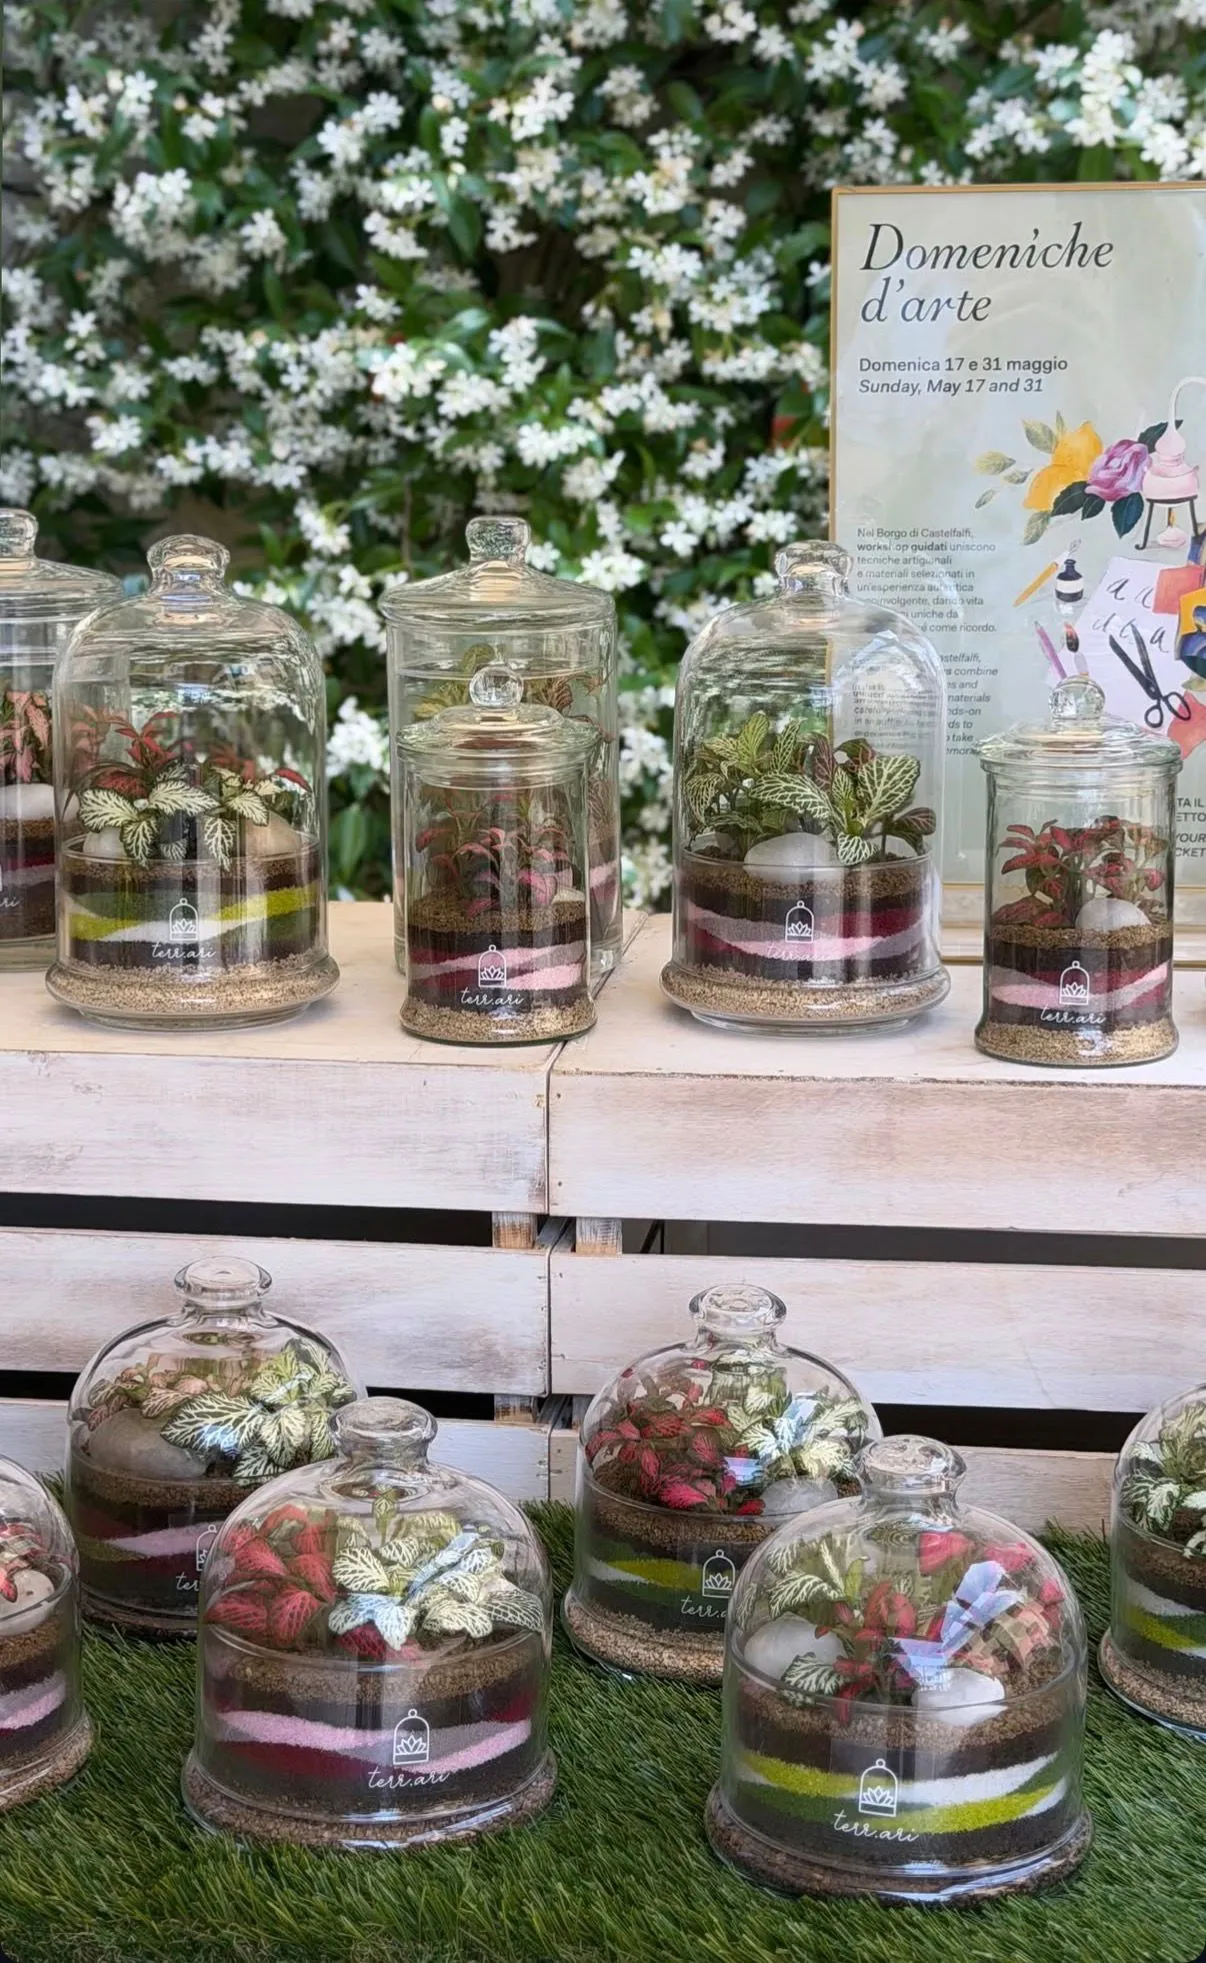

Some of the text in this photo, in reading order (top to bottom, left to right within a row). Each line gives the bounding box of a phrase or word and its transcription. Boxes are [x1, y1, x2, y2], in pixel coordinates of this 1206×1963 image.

[859, 221, 1114, 271] Domeniche
[861, 276, 991, 322] d'arte
[859, 355, 1068, 375] Domenica 17 e 31 maggio
[859, 377, 1043, 397] Sunday, May 17 and 31
[876, 527, 908, 540] Borgo
[909, 527, 919, 538] di
[911, 541, 948, 553] guidati
[950, 542, 997, 552] uniscono
[857, 555, 900, 565] tecniche
[857, 570, 864, 578] e
[865, 568, 908, 578] materiali
[965, 568, 975, 578] in
[966, 595, 985, 605] vita
[911, 609, 944, 619] uniche
[945, 609, 959, 619] da
[928, 623, 958, 632] come
[959, 622, 997, 633] ricordo.
[953, 667, 999, 676] combine
[958, 680, 979, 689] and
[962, 719, 974, 729] to
[952, 732, 974, 742] take
[833, 1809, 919, 1842] terr.ari
